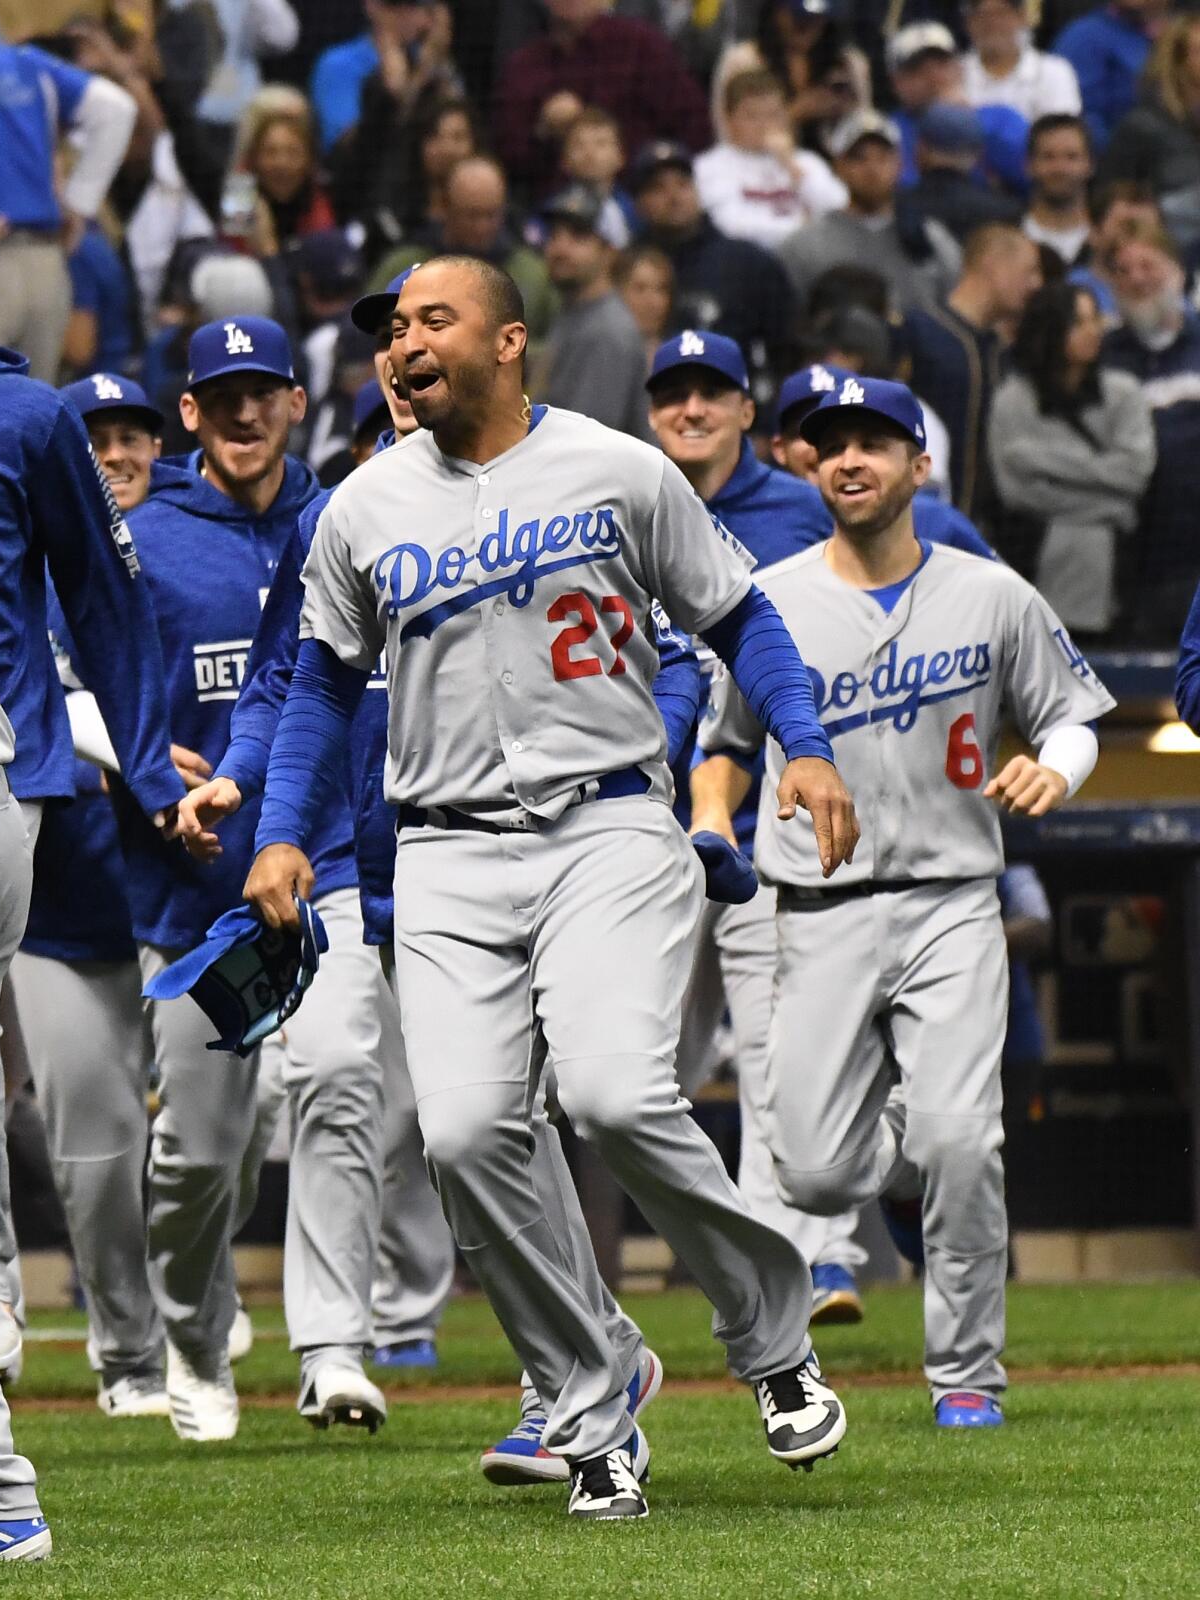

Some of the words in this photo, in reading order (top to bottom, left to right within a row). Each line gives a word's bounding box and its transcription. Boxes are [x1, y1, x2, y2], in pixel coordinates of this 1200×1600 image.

[223, 323, 254, 355] LA
[840, 379, 865, 405] LA
[374, 508, 622, 618] Dodgers
[547, 591, 635, 682] 27
[194, 653, 248, 691] DET
[944, 712, 984, 790] 6
